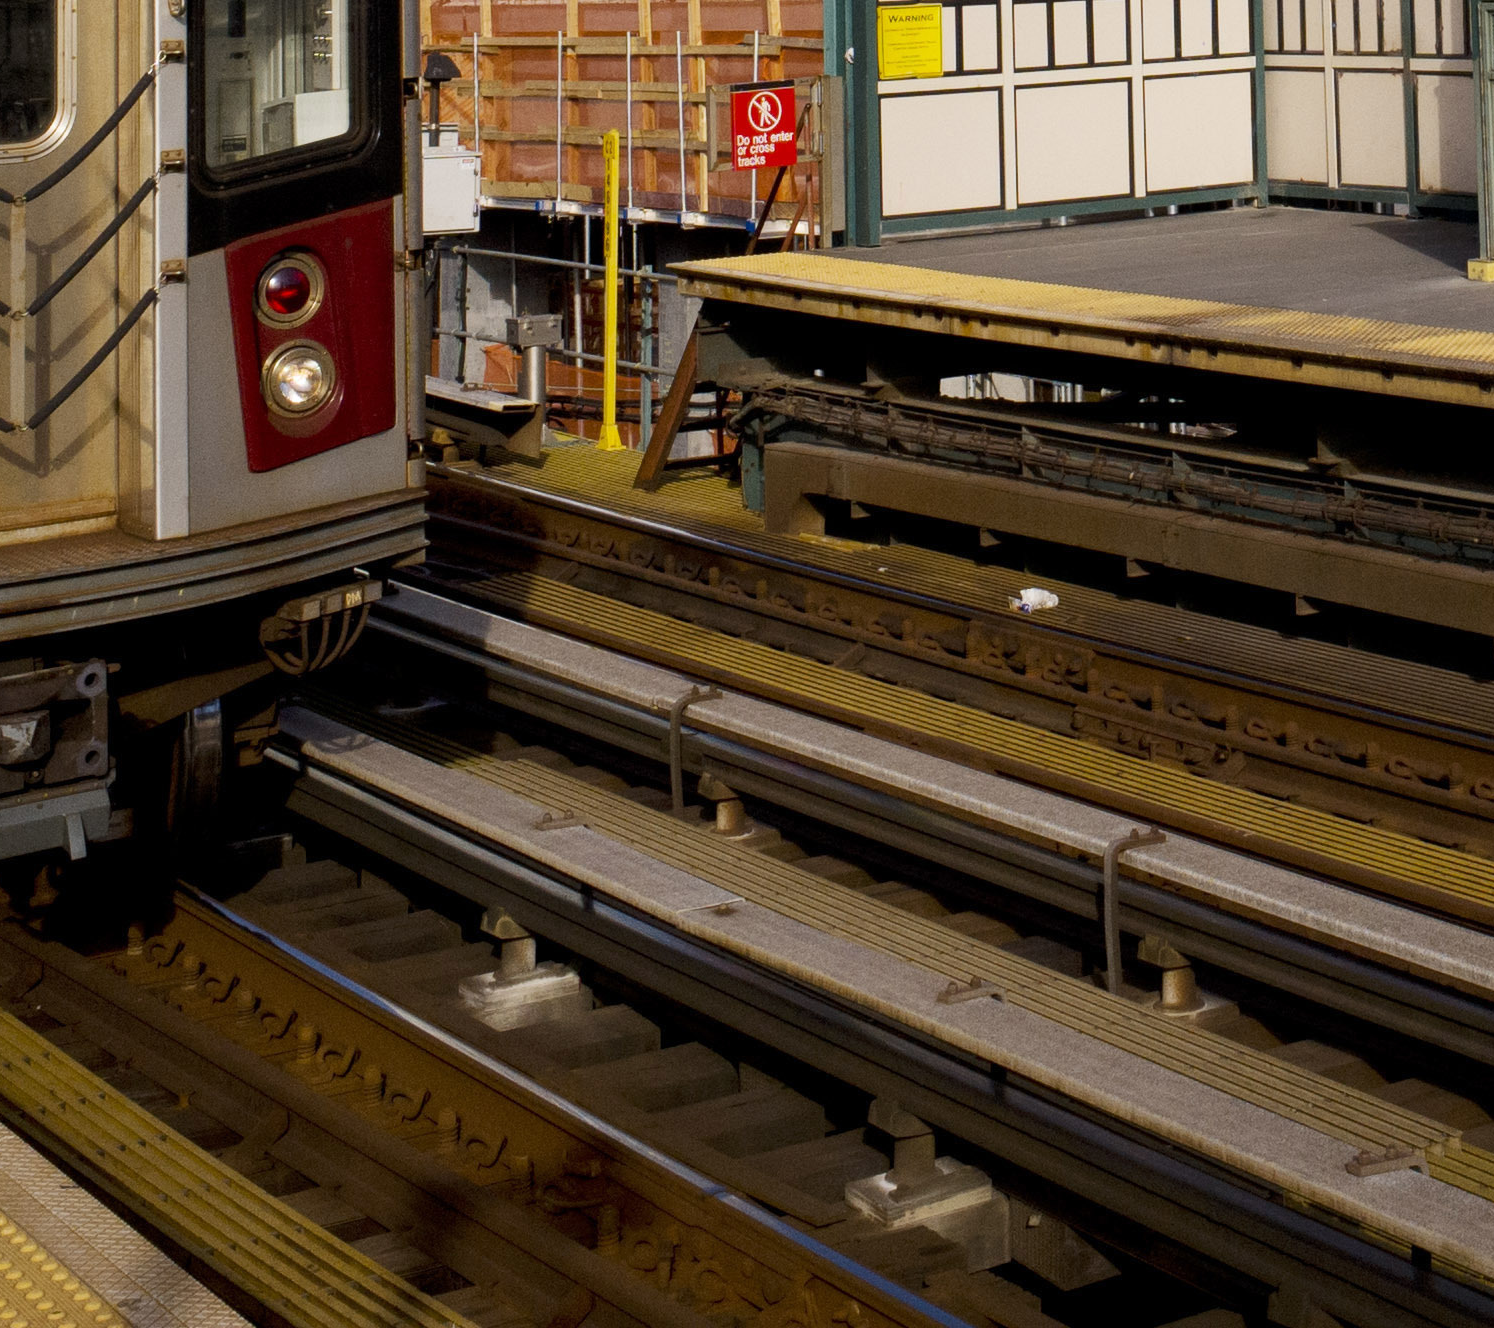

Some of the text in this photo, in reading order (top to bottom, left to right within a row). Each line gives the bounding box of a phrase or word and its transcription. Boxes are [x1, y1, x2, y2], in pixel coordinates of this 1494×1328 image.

[888, 14, 934, 23] WARNING
[736, 131, 794, 146] Do not enter
[737, 143, 775, 155] or cross
[737, 155, 766, 167] tracks
